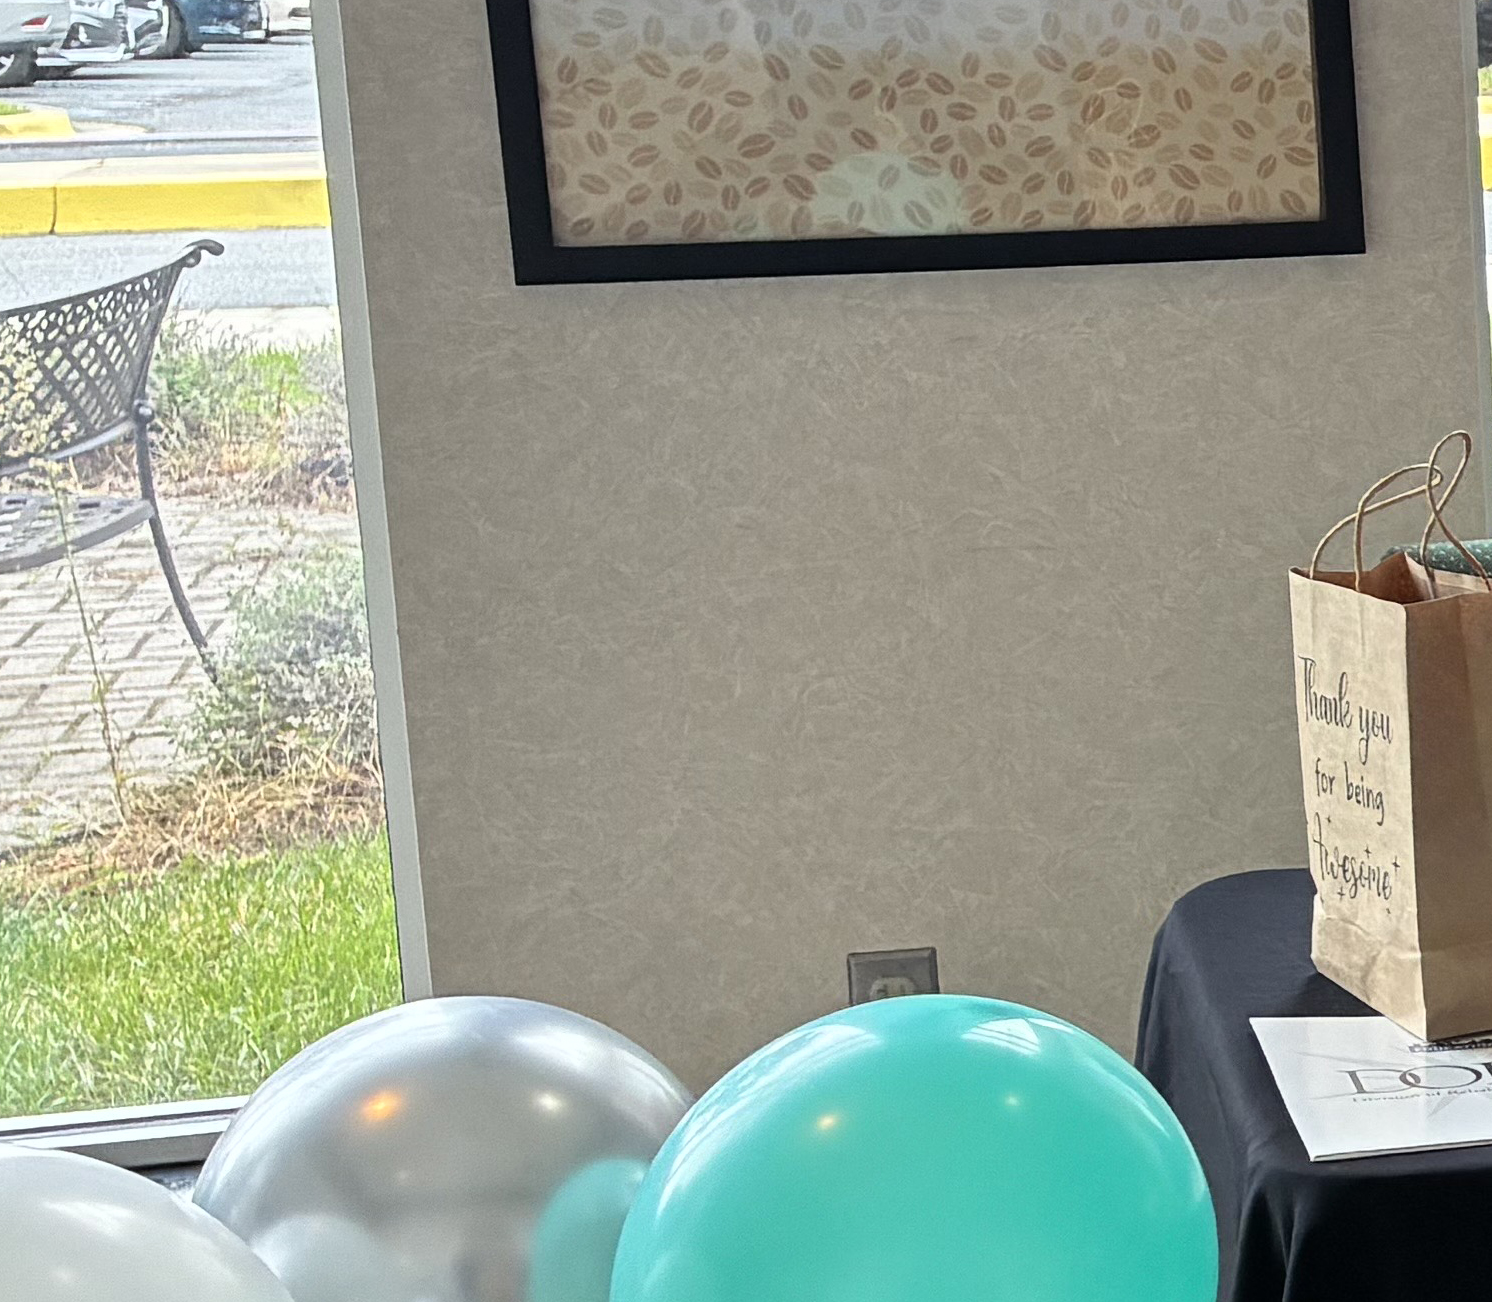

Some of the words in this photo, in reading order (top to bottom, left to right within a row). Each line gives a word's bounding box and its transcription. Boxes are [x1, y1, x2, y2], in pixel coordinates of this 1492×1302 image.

[1298, 655, 1353, 728] Thank
[1358, 706, 1393, 765] you
[1315, 757, 1335, 797] for
[1344, 761, 1384, 826] being
